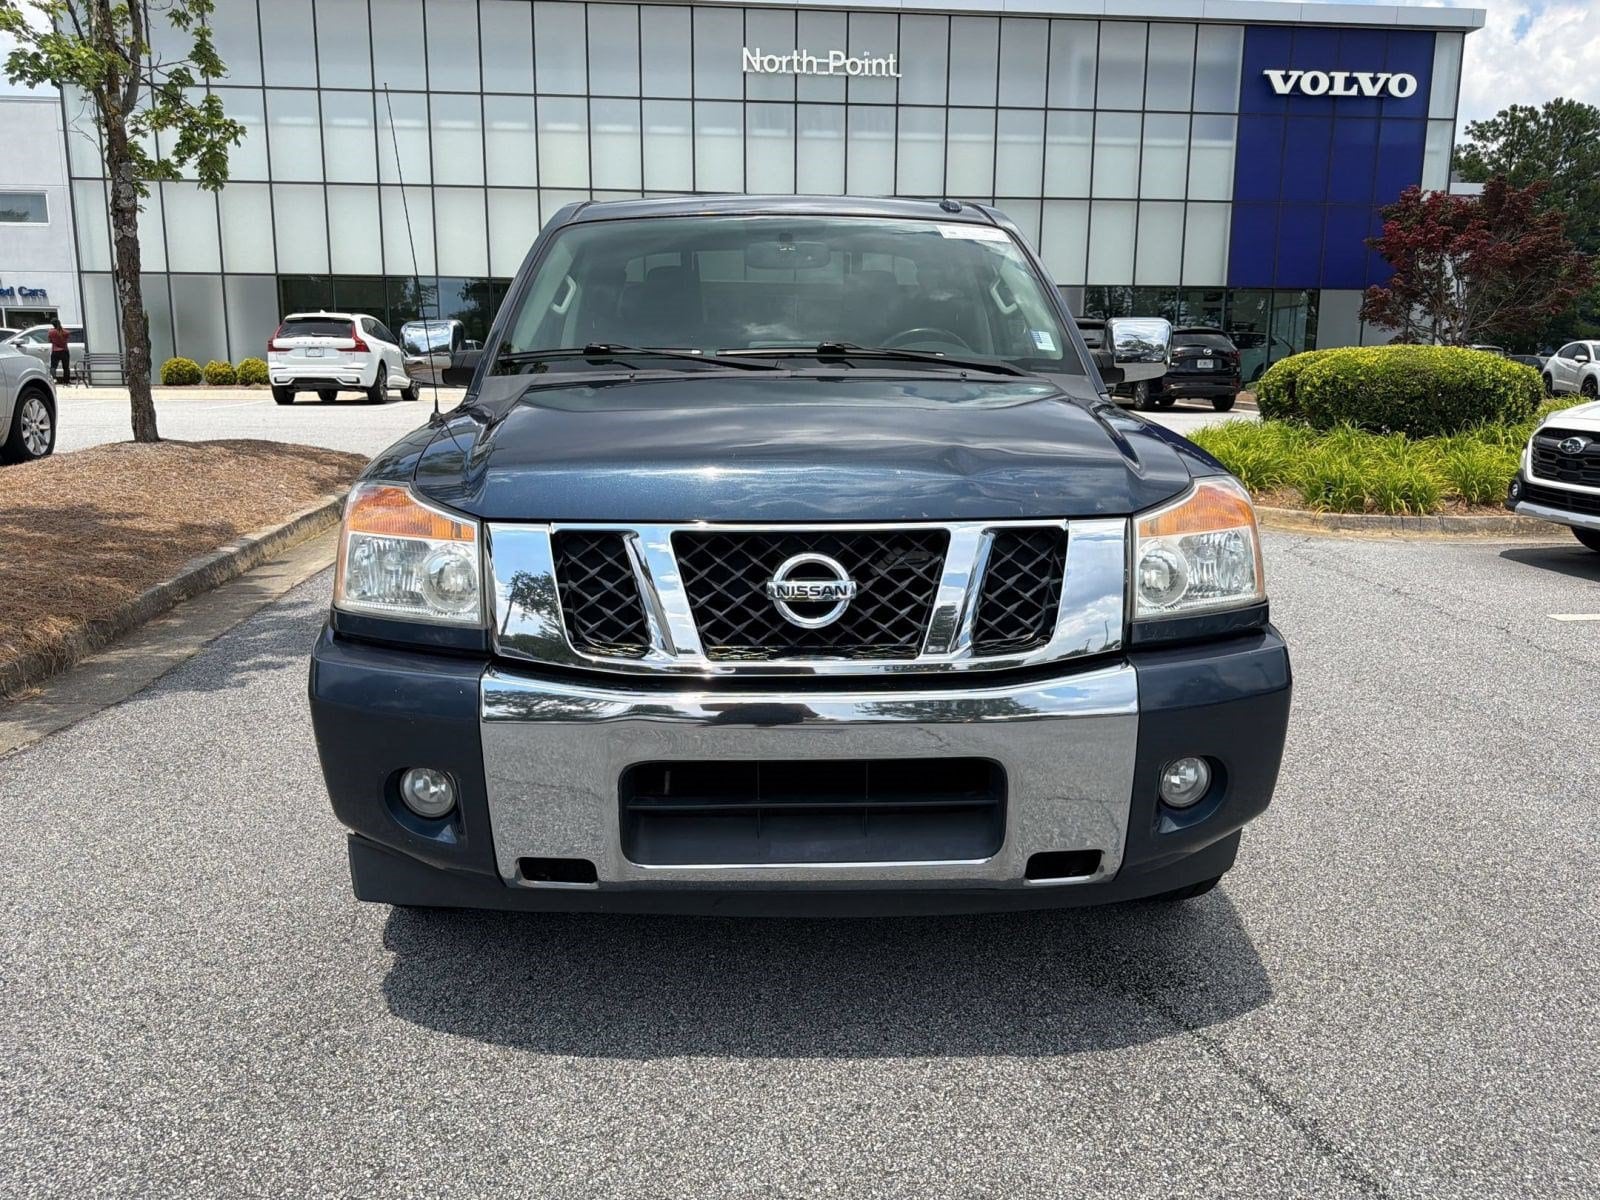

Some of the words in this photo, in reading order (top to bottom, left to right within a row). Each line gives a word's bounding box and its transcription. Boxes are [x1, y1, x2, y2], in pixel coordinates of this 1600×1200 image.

[742, 47, 818, 74] North
[828, 50, 897, 76] Point
[1263, 69, 1418, 98] VOLVO
[18, 286, 47, 297] Cars
[776, 584, 848, 597] NISSAN
